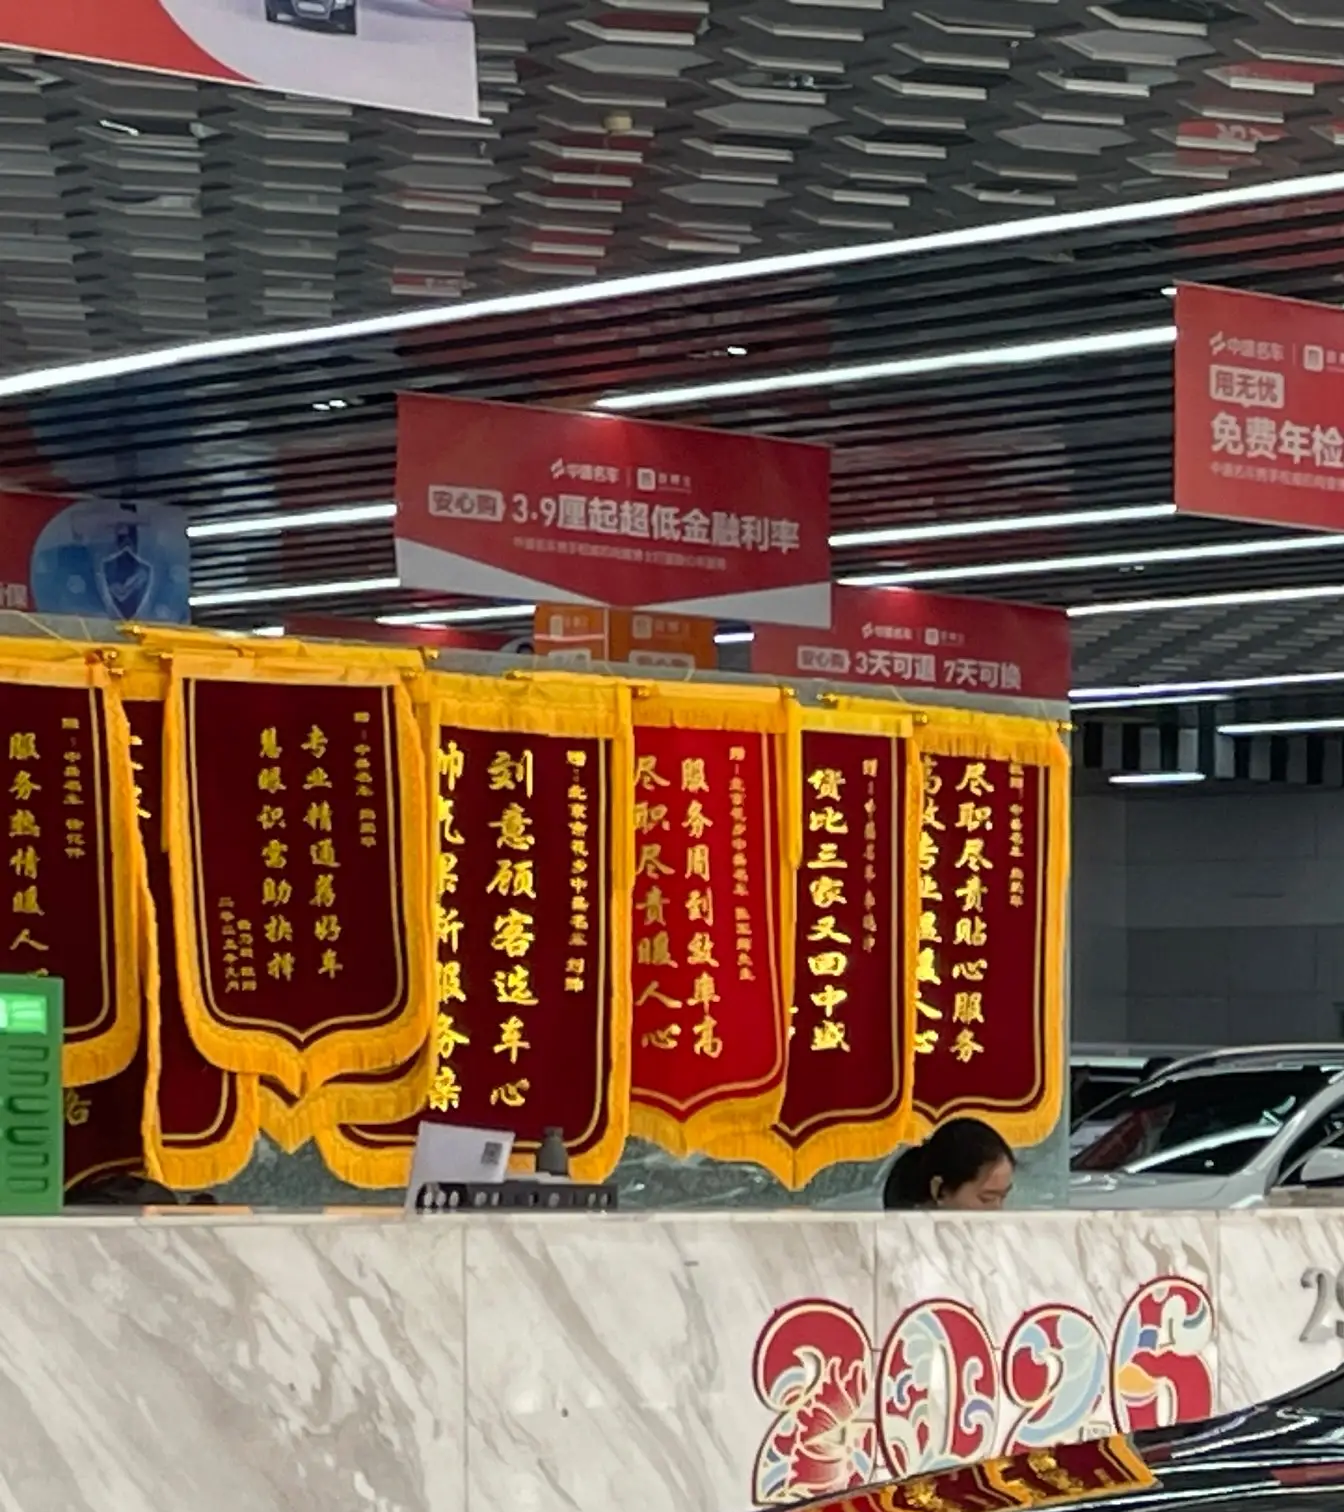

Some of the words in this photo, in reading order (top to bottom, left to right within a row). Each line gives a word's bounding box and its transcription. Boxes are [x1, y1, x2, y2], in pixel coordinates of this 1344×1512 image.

[1215, 370, 1278, 402] 用无忧
[432, 489, 499, 518] 安心购
[855, 650, 936, 682] 3天可退
[944, 659, 1021, 690] 7天可换
[8, 732, 49, 977] 服务热情暖人
[633, 755, 682, 1051] 尽职尽责暖人心
[950, 762, 994, 1063] 尽职尽责贴心服务
